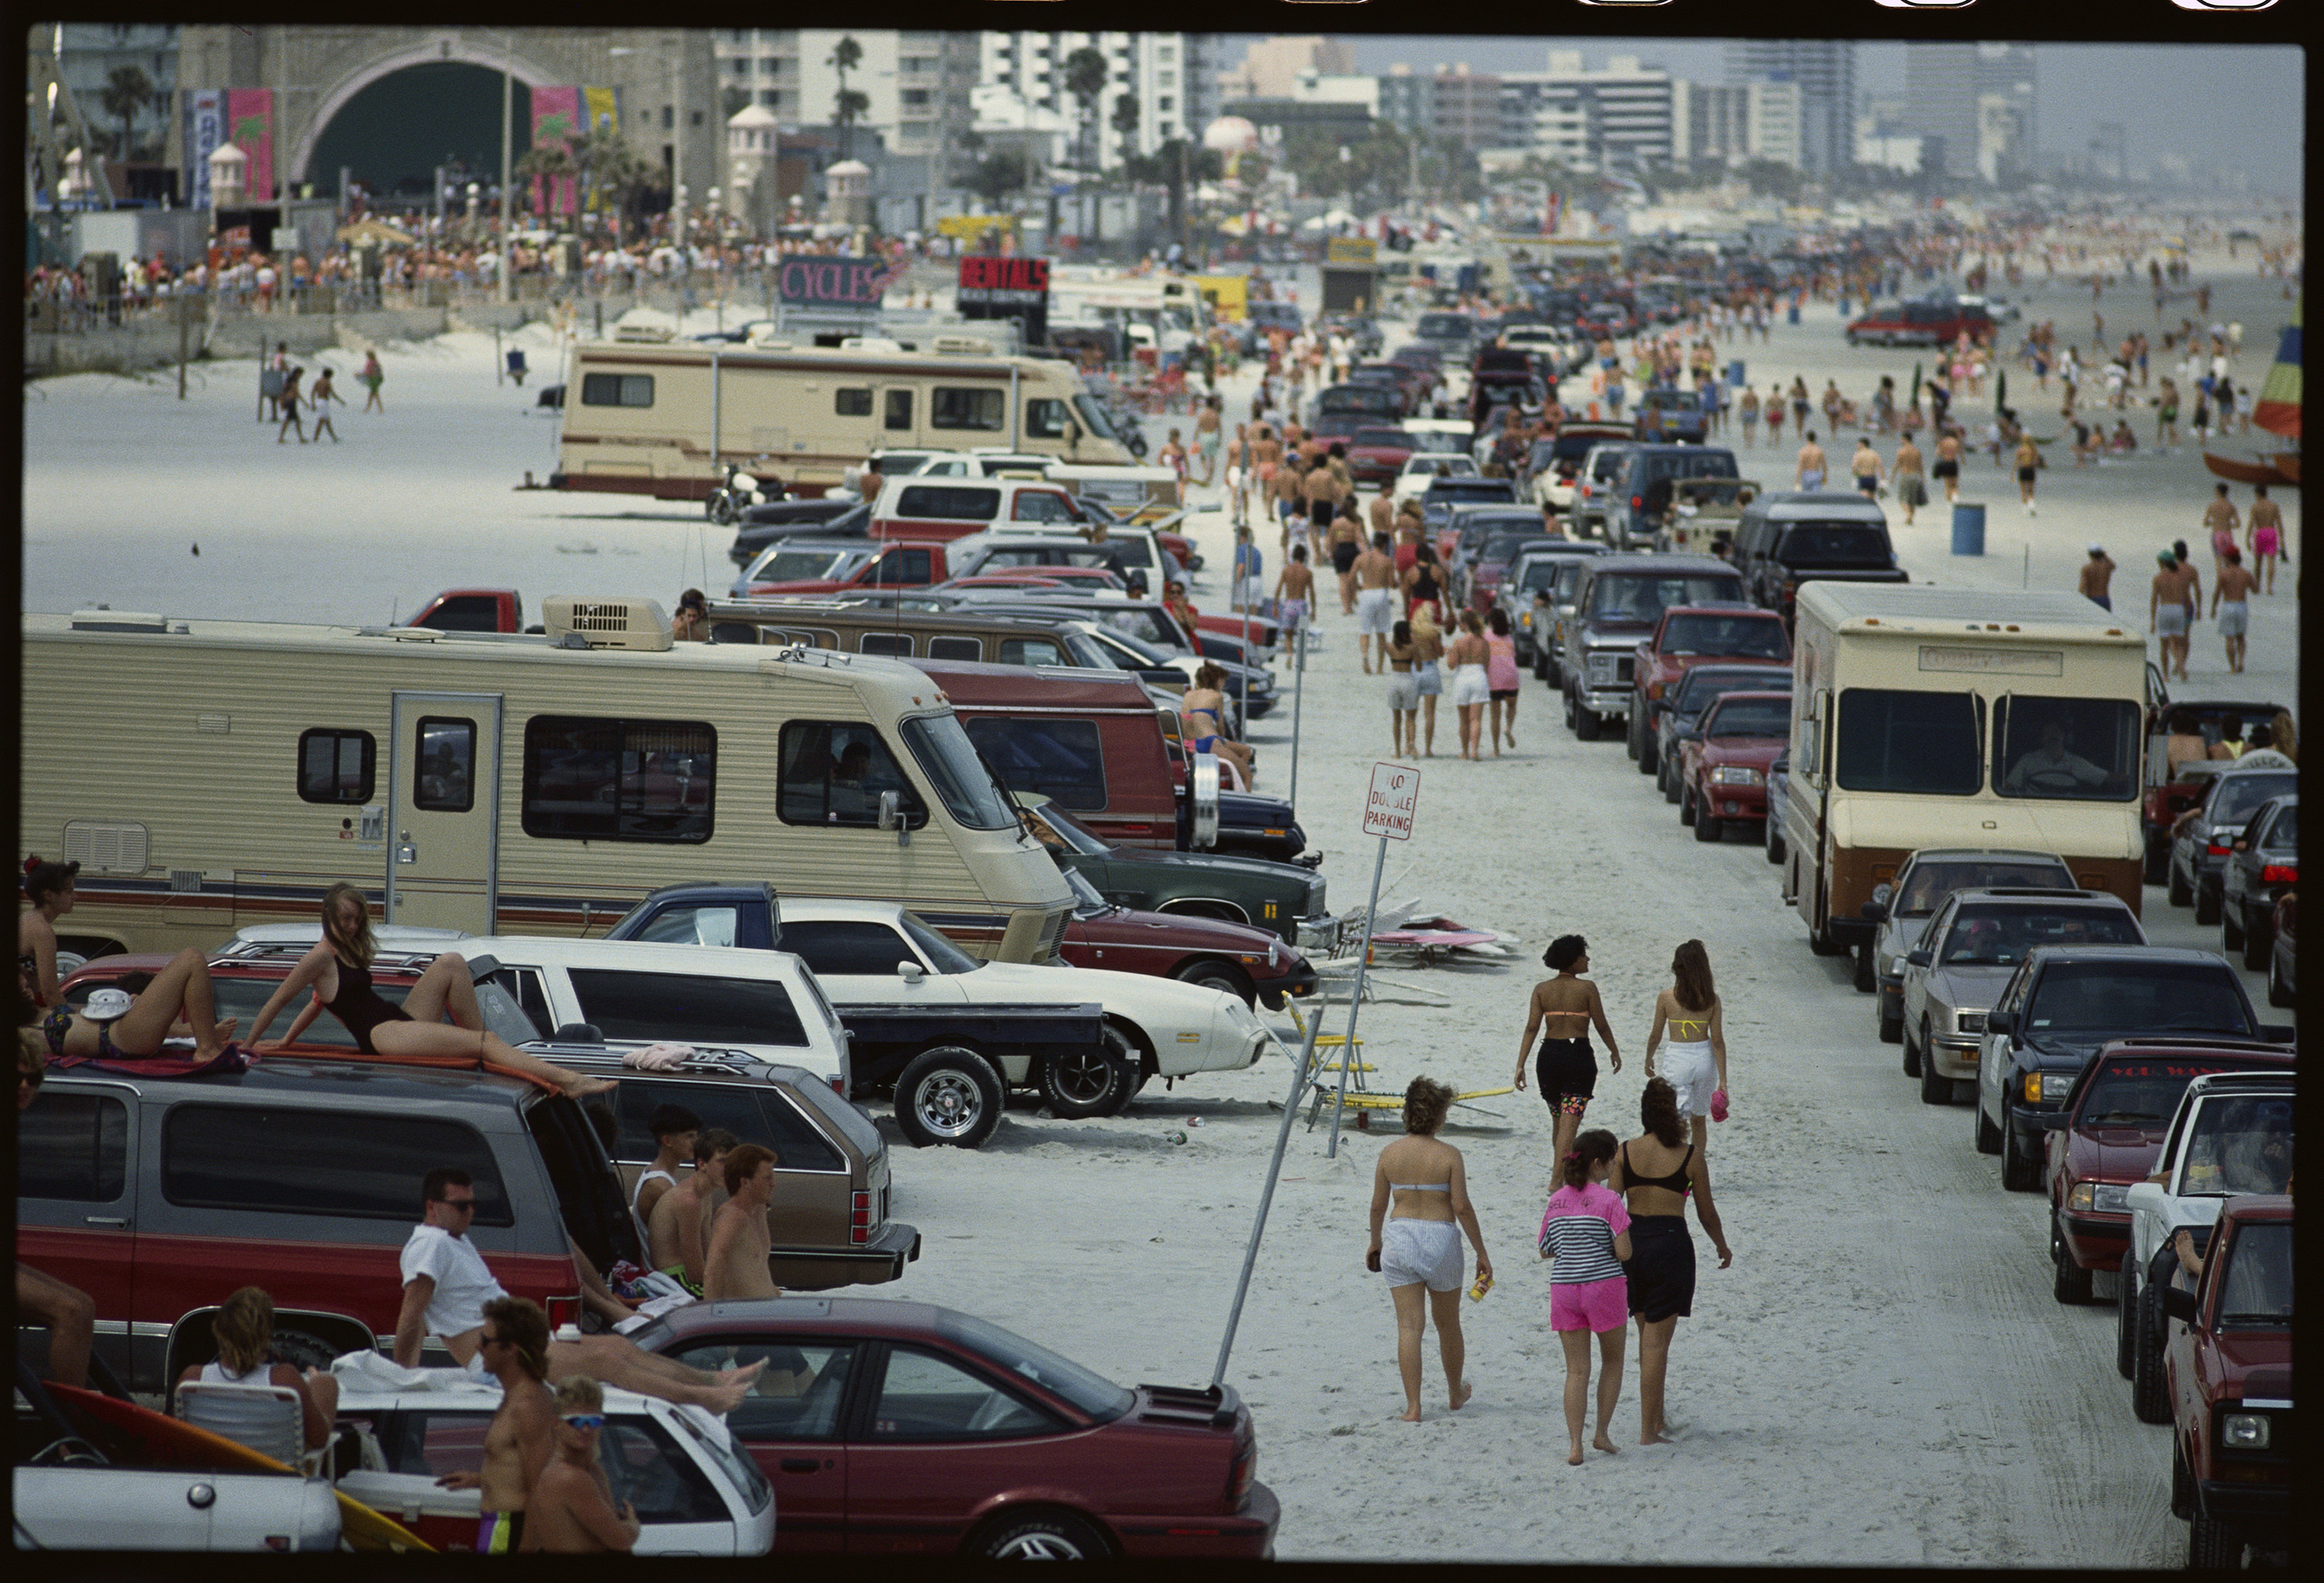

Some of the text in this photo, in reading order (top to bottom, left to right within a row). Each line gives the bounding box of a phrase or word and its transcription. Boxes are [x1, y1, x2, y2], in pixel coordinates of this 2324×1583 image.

[781, 262, 879, 303] CYCLES
[960, 256, 1049, 291] RENTALS
[1367, 810, 1410, 831] PARKING
[2112, 1066, 2240, 1077] YOU WAN
